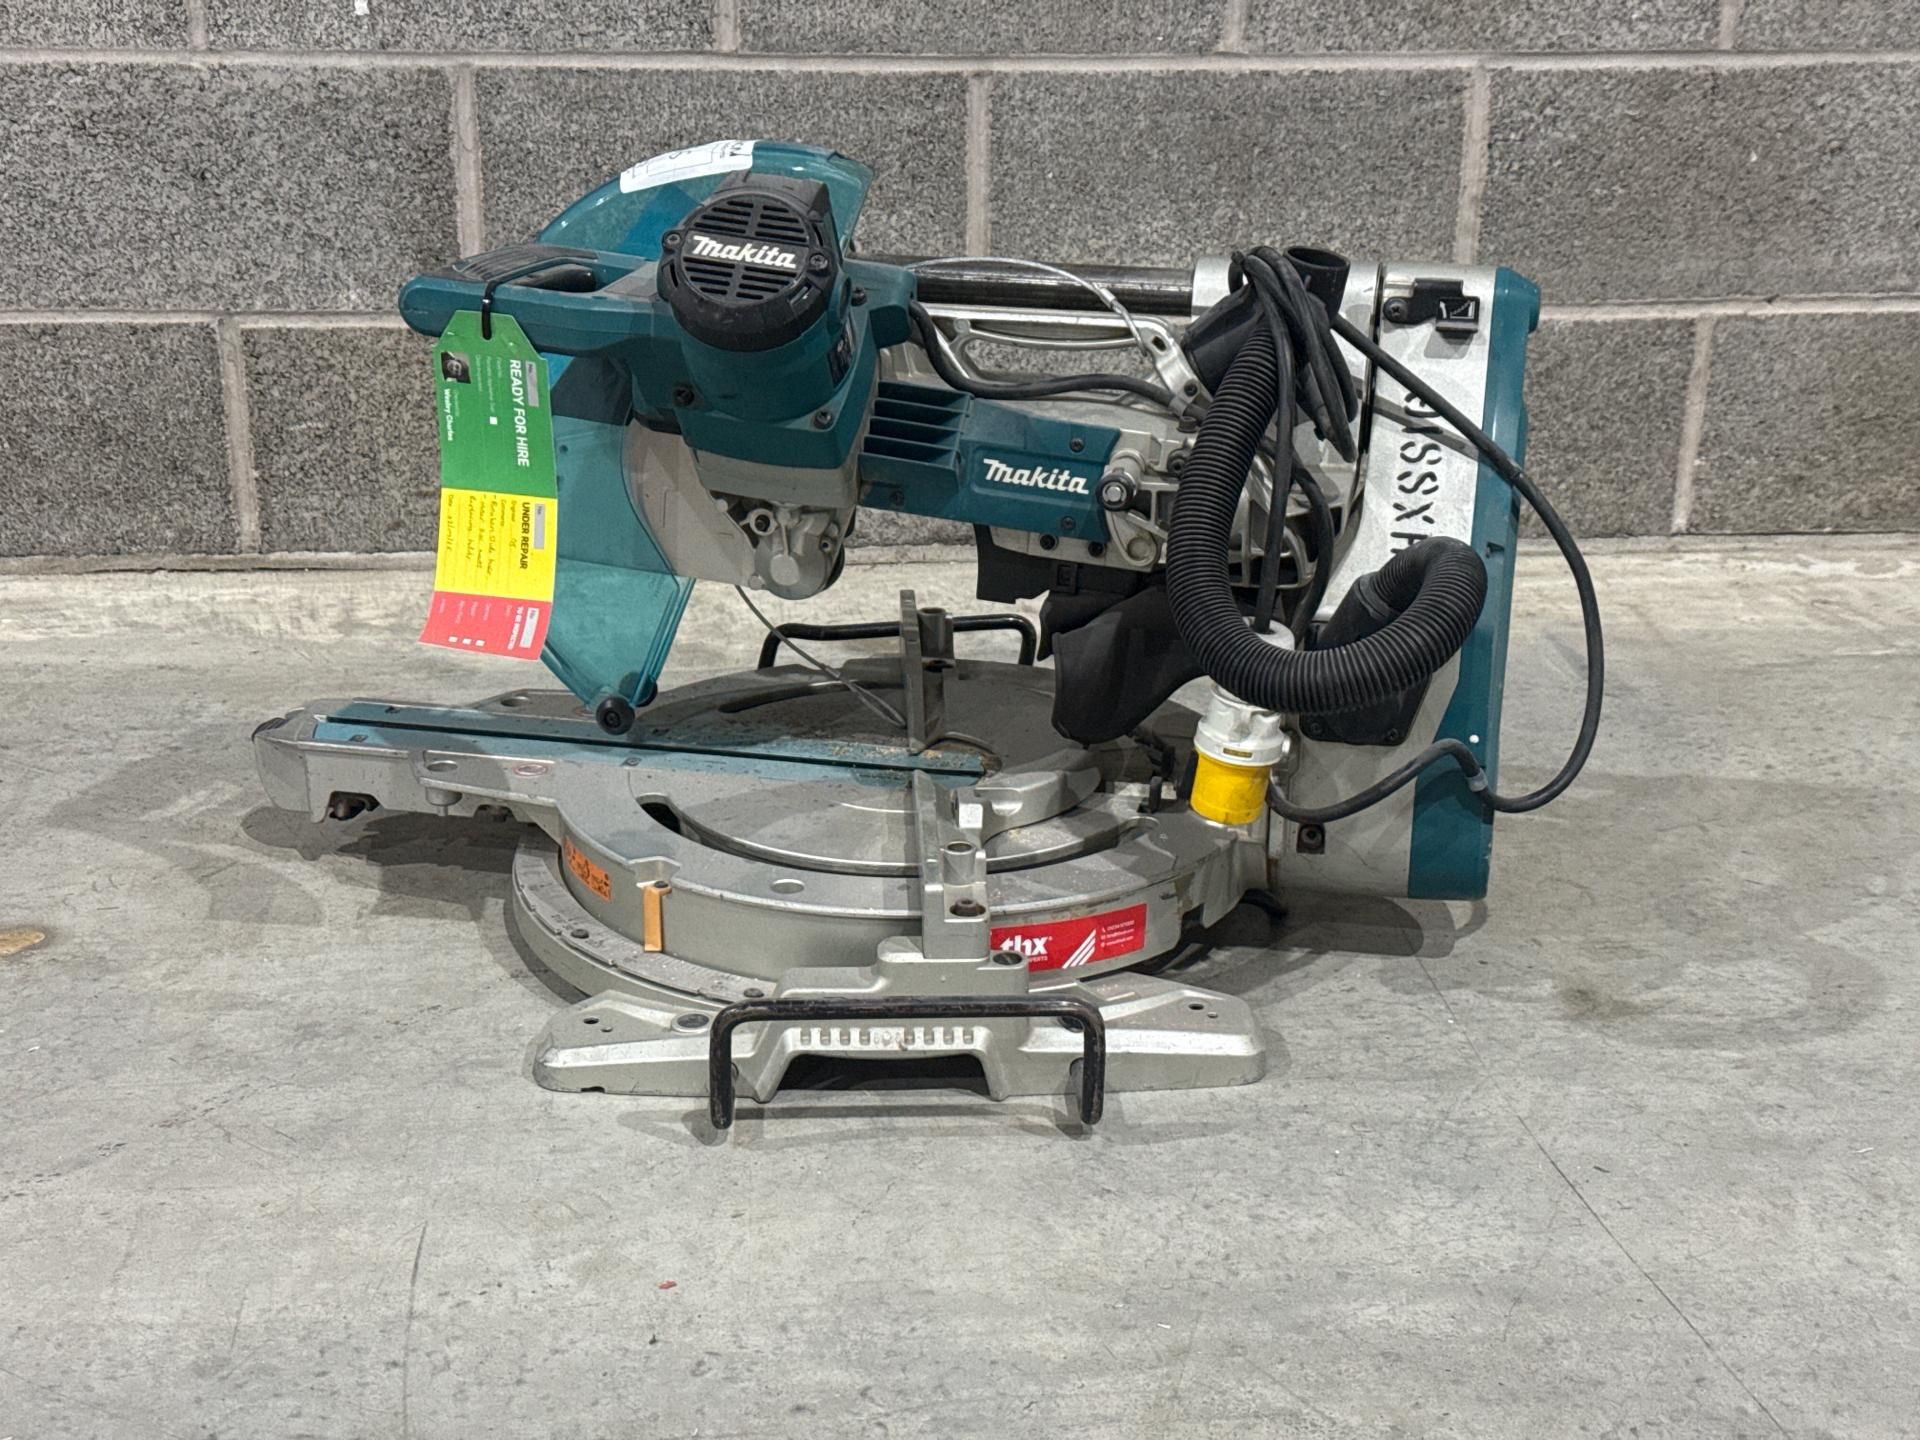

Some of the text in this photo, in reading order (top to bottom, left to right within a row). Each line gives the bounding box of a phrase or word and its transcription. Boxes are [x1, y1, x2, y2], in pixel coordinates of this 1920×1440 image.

[692, 235, 797, 269] Makita
[509, 360, 530, 468] READY FOR HIRE
[983, 458, 1090, 495] Makita
[519, 502, 531, 570] UNDER REPAIR
[999, 935, 1049, 956] thx
